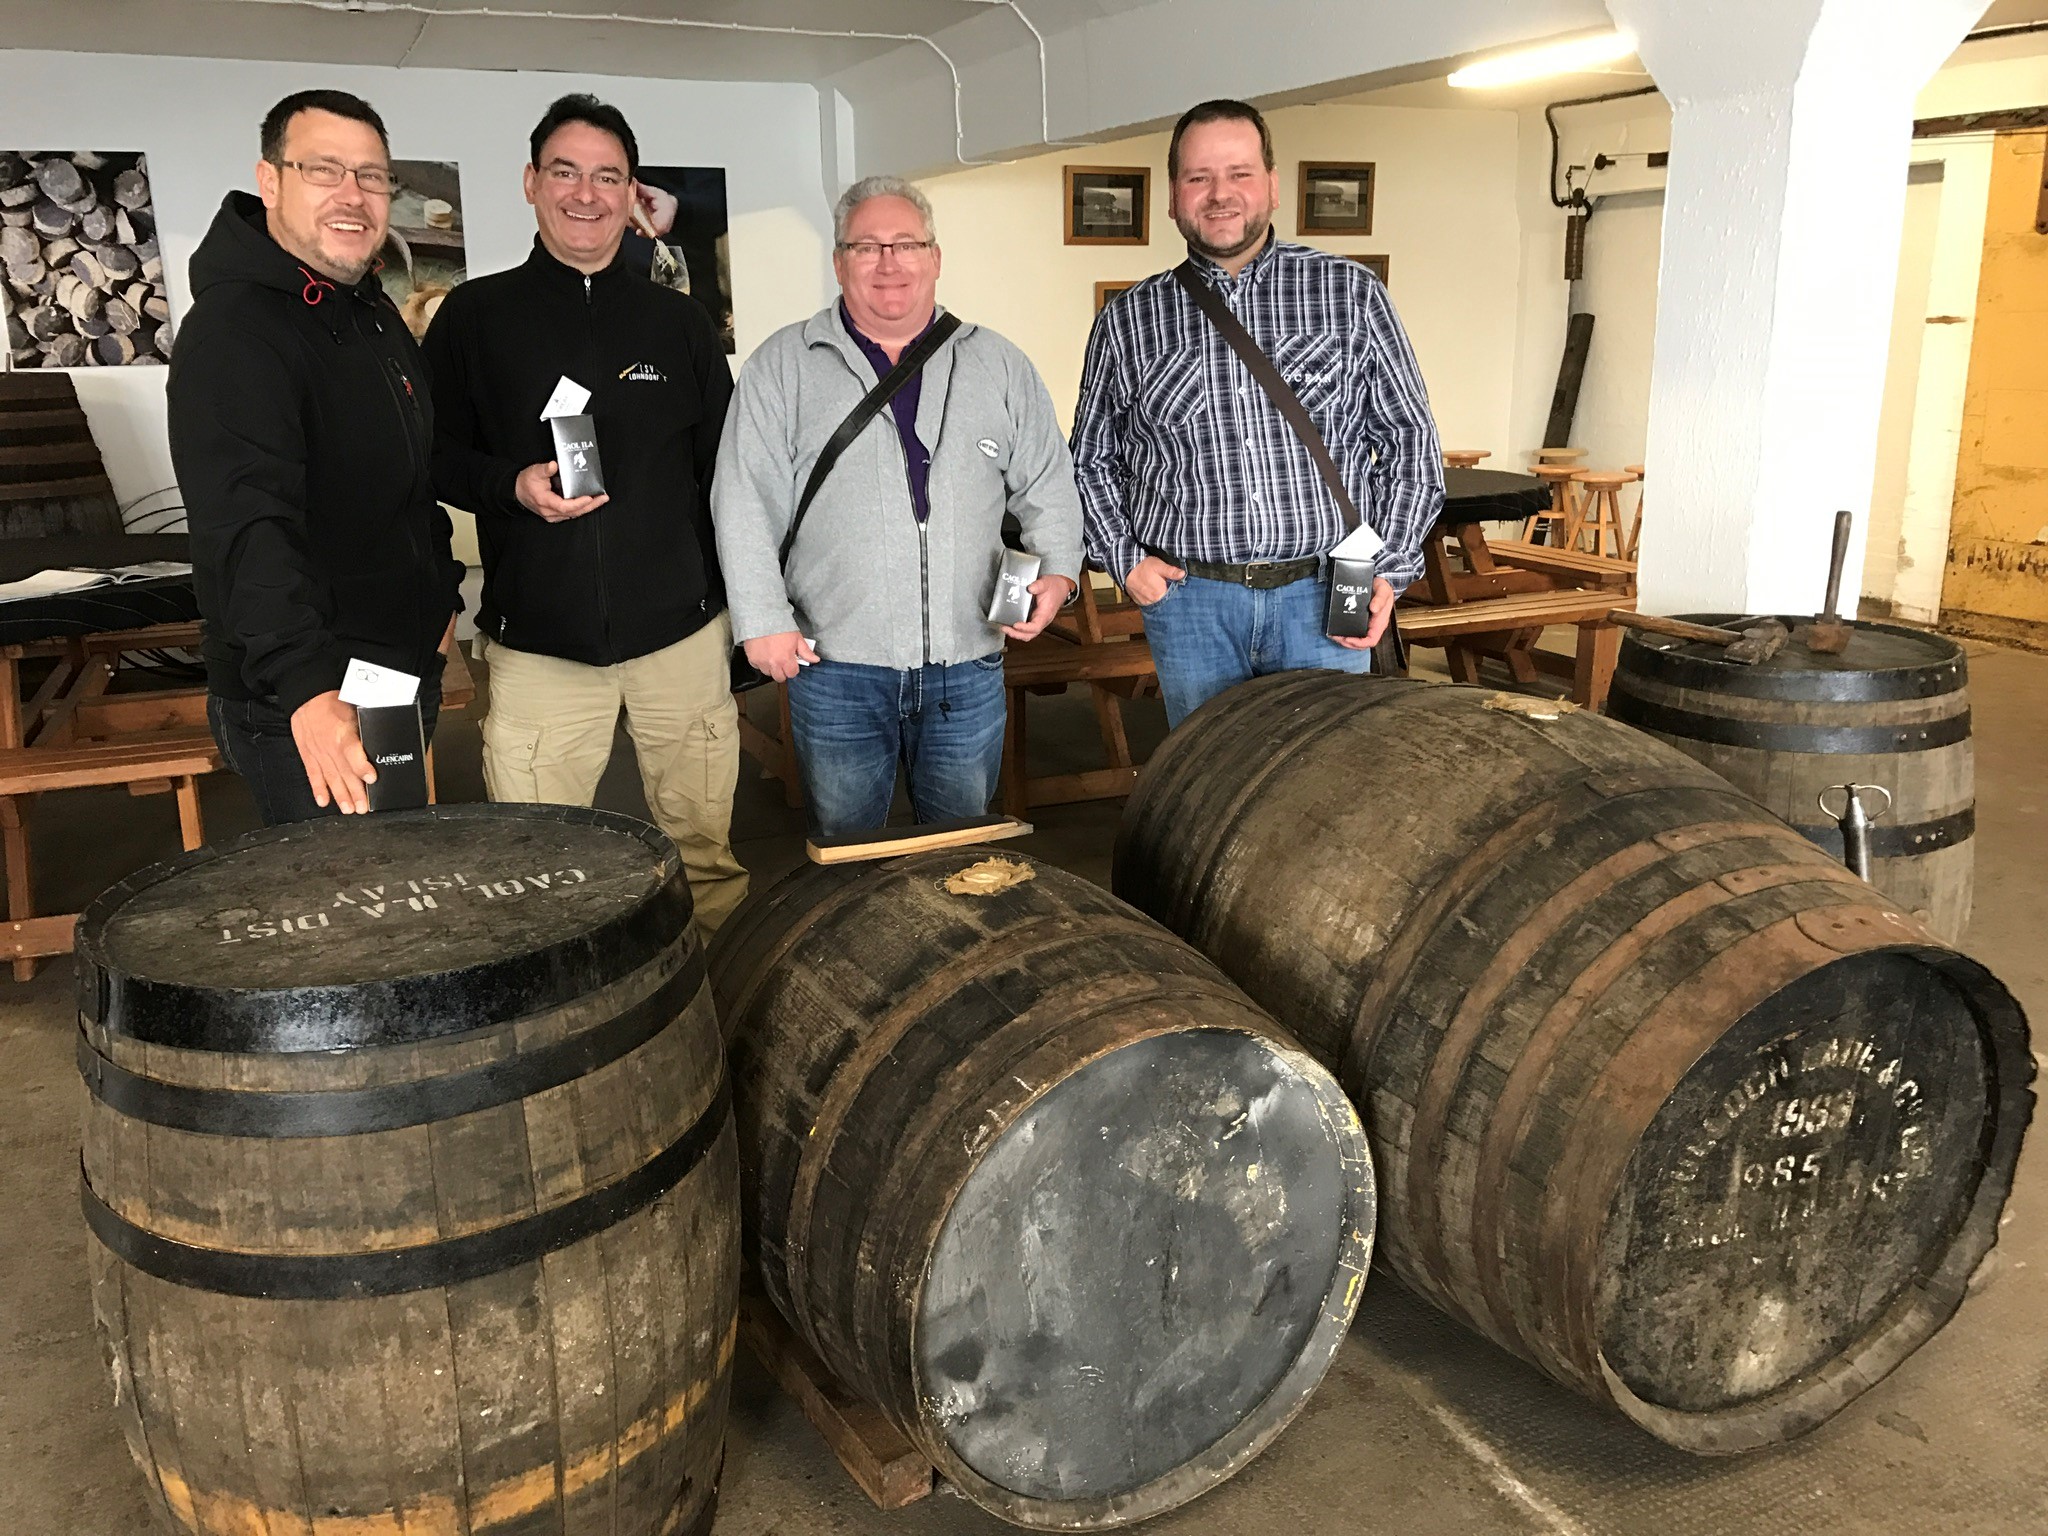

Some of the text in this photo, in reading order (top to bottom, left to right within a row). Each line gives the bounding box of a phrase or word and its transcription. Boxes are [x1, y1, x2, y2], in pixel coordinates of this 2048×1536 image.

[561, 441, 581, 450] CAOL
[1336, 584, 1356, 593] CAOL
[1356, 586, 1368, 594] ILA
[375, 752, 413, 764] GLENCAIRN
[463, 868, 586, 899] CAOL
[217, 912, 330, 945] DIST
